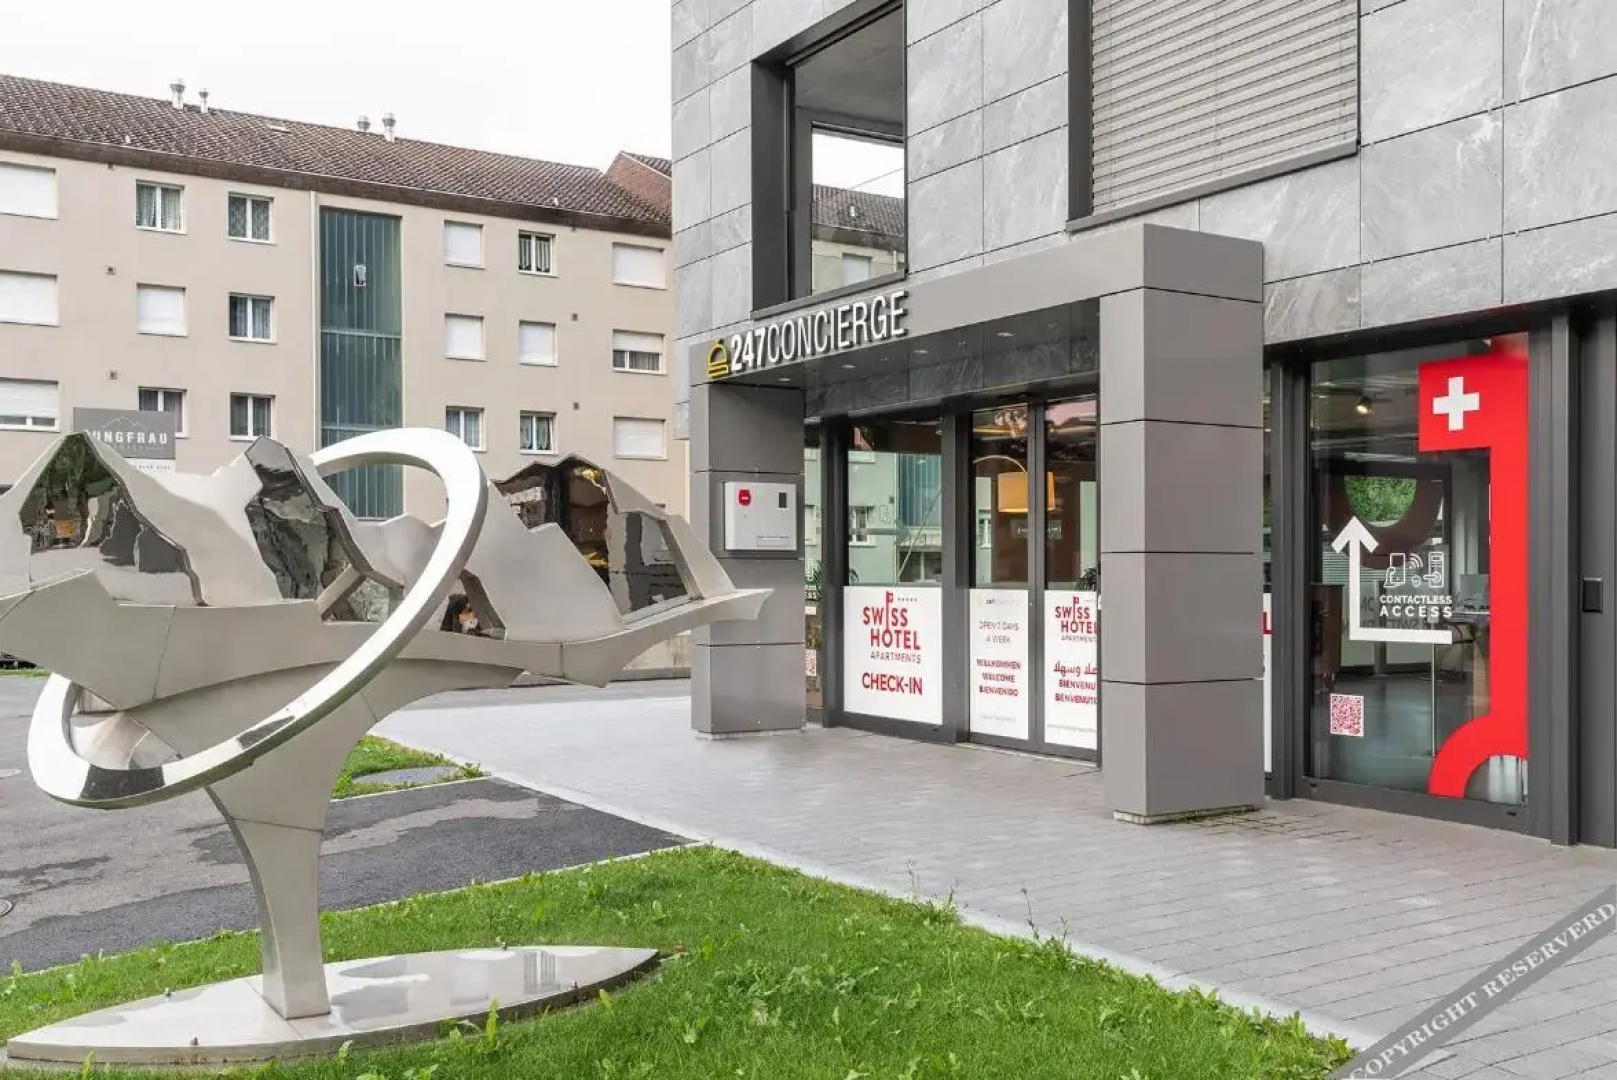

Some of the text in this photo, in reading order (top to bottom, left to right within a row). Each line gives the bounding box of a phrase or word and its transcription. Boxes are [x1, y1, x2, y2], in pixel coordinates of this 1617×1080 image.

[731, 291, 907, 371] 247CONCIERGE
[91, 430, 168, 444] UNGFRAU
[1379, 595, 1452, 605] CONTACTLESS
[862, 600, 908, 627] SWISS
[1055, 602, 1090, 620] SWISS
[1379, 605, 1452, 619] ACCESS
[870, 628, 921, 651] HOTEL
[870, 651, 922, 664] APARTMENTS
[976, 659, 1021, 669] WILLKOMMEN
[862, 672, 923, 696] CHECK-IN
[982, 672, 1015, 683] WELCOME
